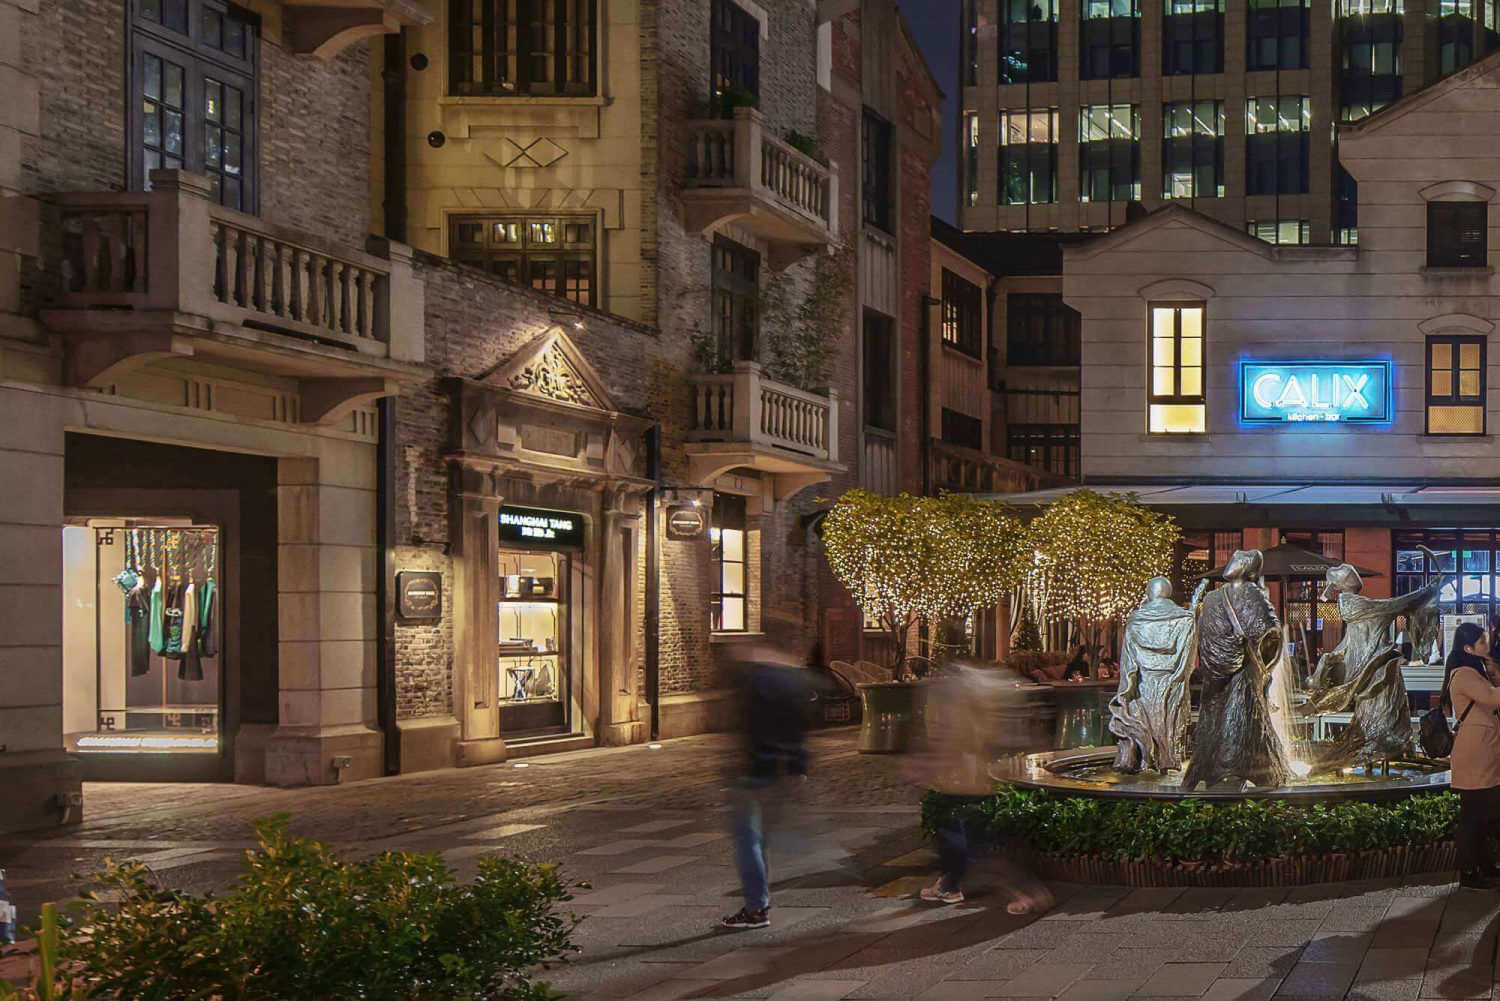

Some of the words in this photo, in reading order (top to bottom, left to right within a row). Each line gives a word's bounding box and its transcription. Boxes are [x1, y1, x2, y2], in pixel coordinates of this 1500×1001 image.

[1253, 373, 1369, 409] CALIX
[500, 514, 549, 527] SHANGHAI
[549, 518, 573, 530] TANG
